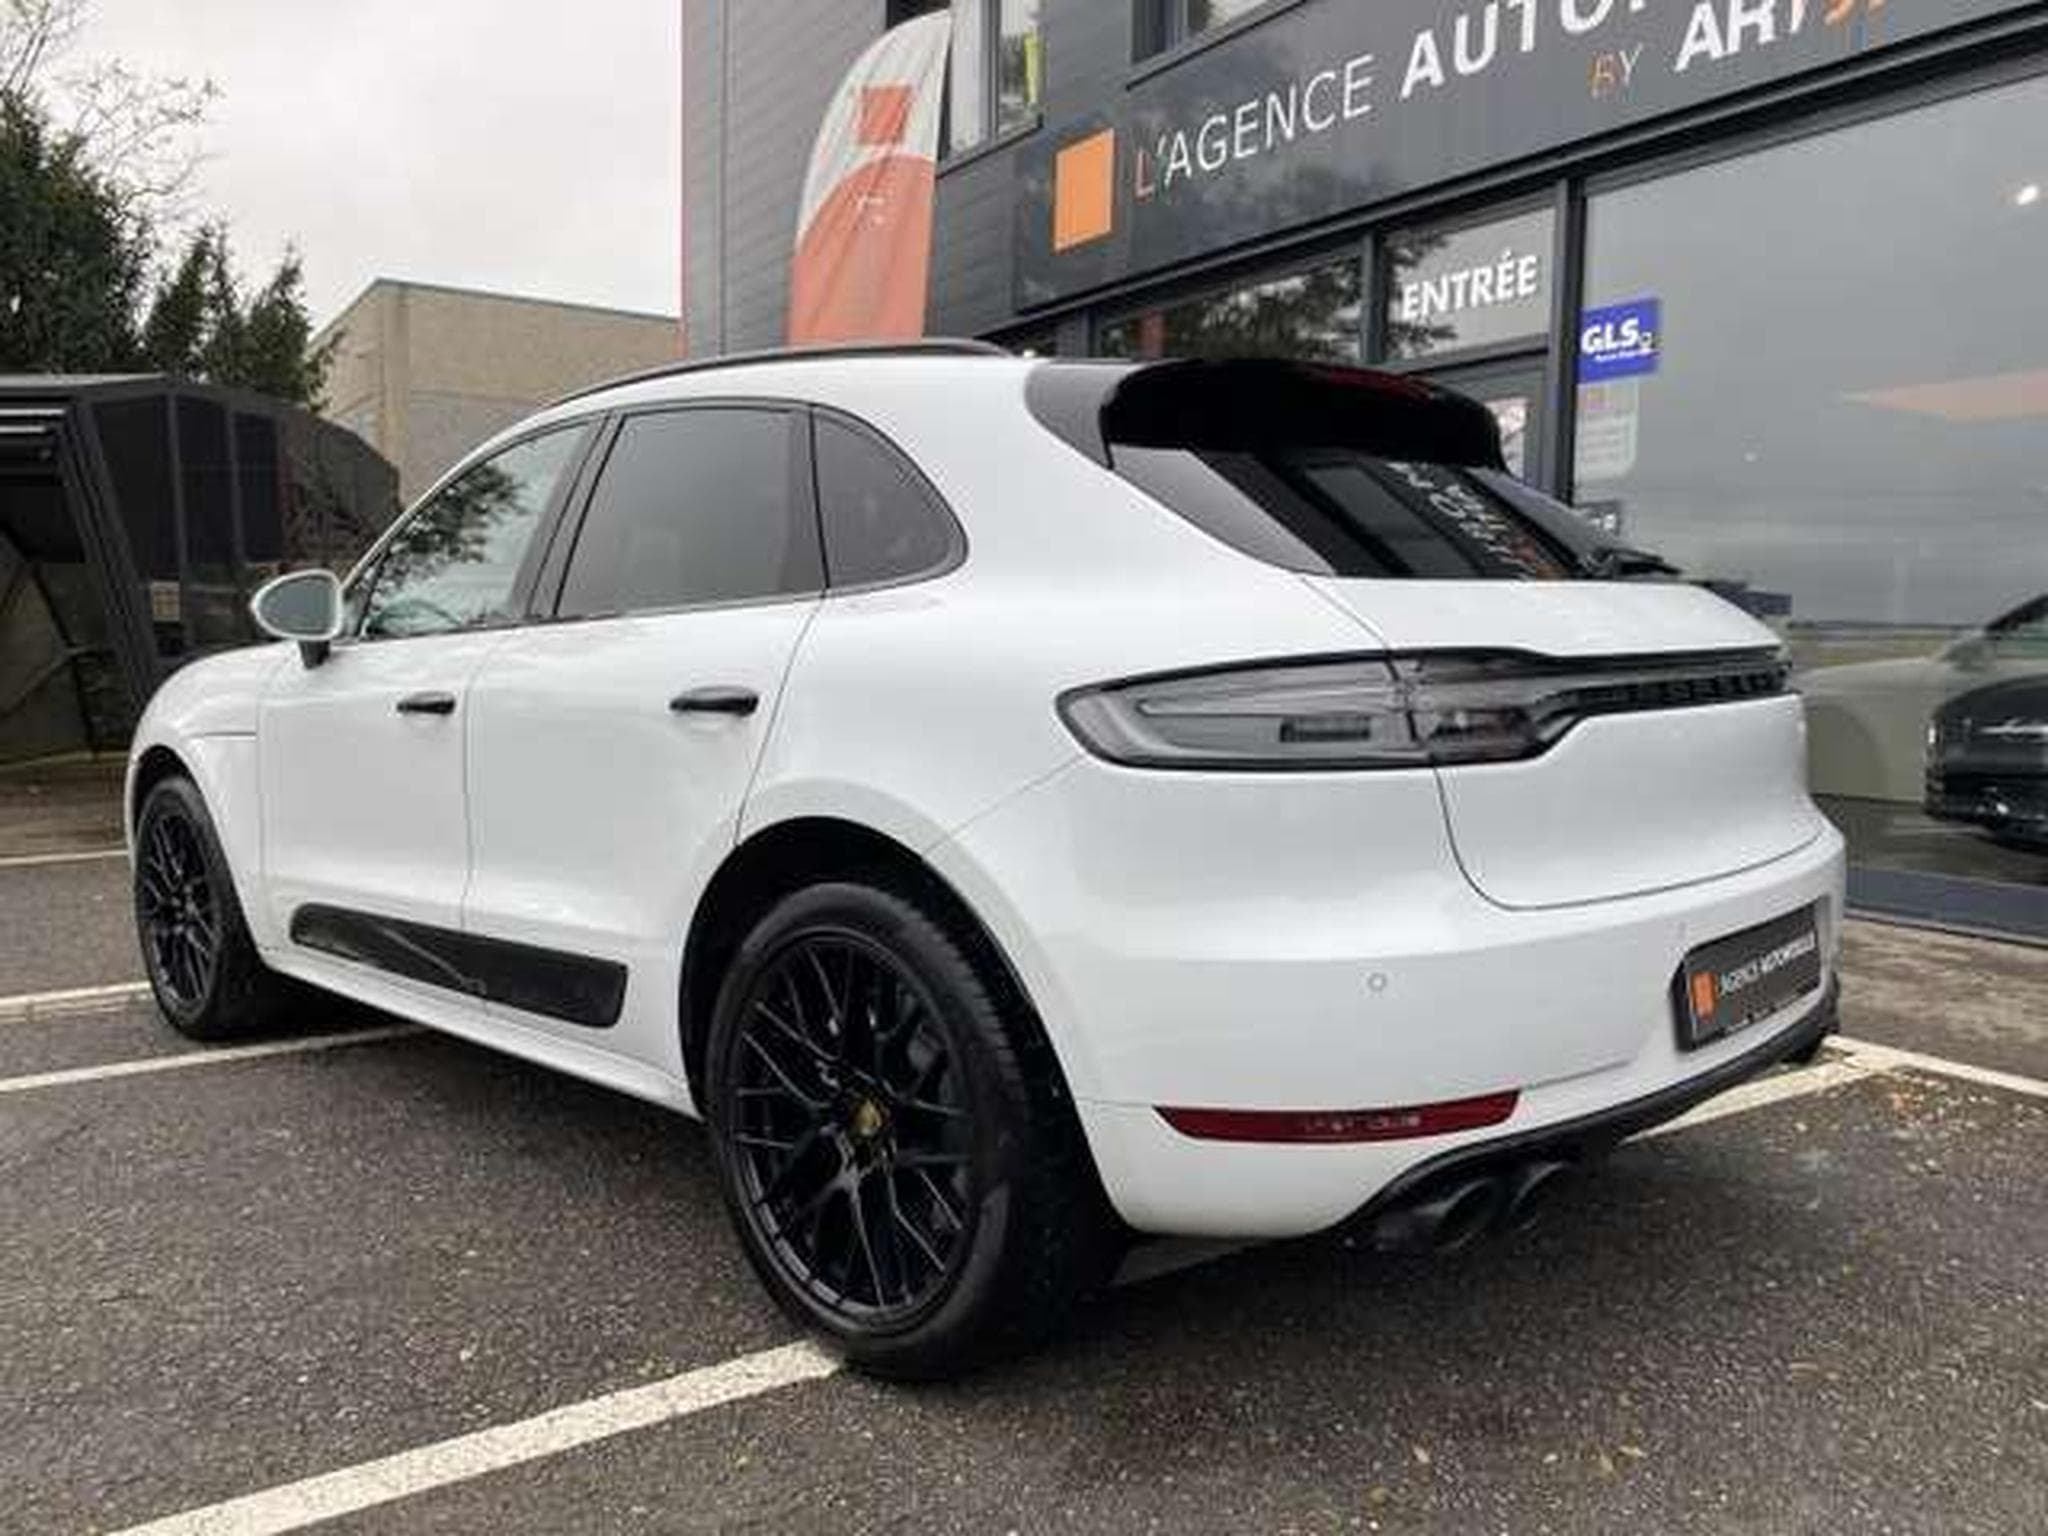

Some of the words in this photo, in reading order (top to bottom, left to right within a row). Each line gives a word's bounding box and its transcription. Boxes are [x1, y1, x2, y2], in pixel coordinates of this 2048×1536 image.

[1135, 54, 1375, 198] L'AGENCE
[1401, 0, 1648, 99] AUTO
[1590, 43, 1644, 98] BY
[1400, 249, 1538, 321] ENTRÉE
[1581, 317, 1639, 355] GLS
